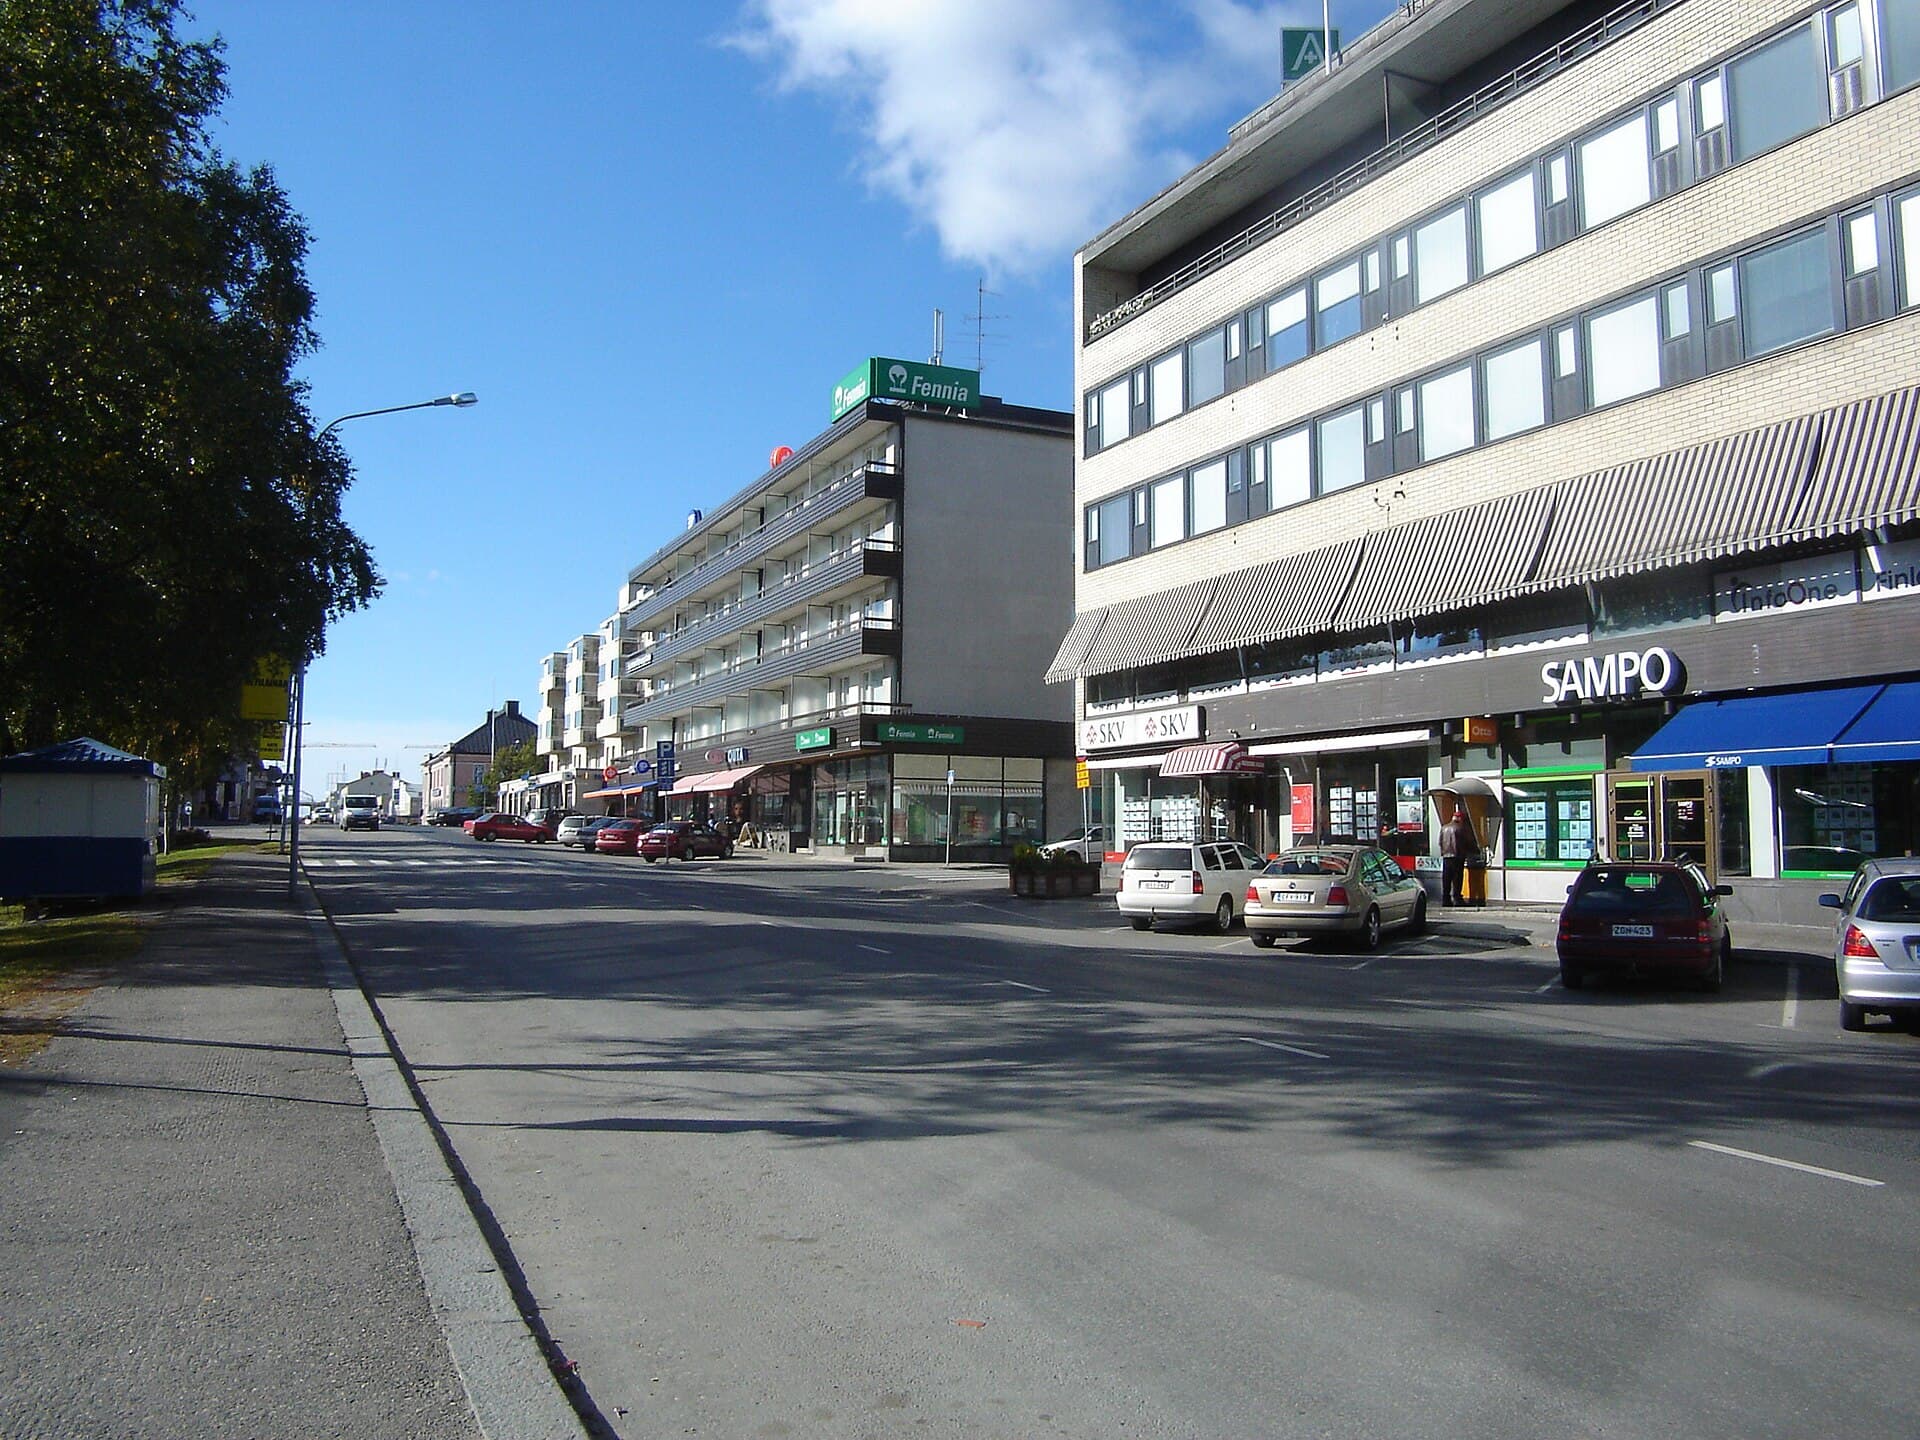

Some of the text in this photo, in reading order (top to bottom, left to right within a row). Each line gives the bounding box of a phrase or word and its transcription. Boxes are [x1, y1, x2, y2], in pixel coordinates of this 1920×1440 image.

[843, 378, 866, 408] Fennia
[911, 375, 969, 402] Fennia
[1876, 566, 1920, 593] Finl
[1541, 646, 1671, 704] SAMPO
[1099, 712, 1189, 744] SKV SKV
[660, 742, 672, 757] P
[1715, 755, 1742, 766] SAMPO
[1424, 857, 1442, 869] SKV
